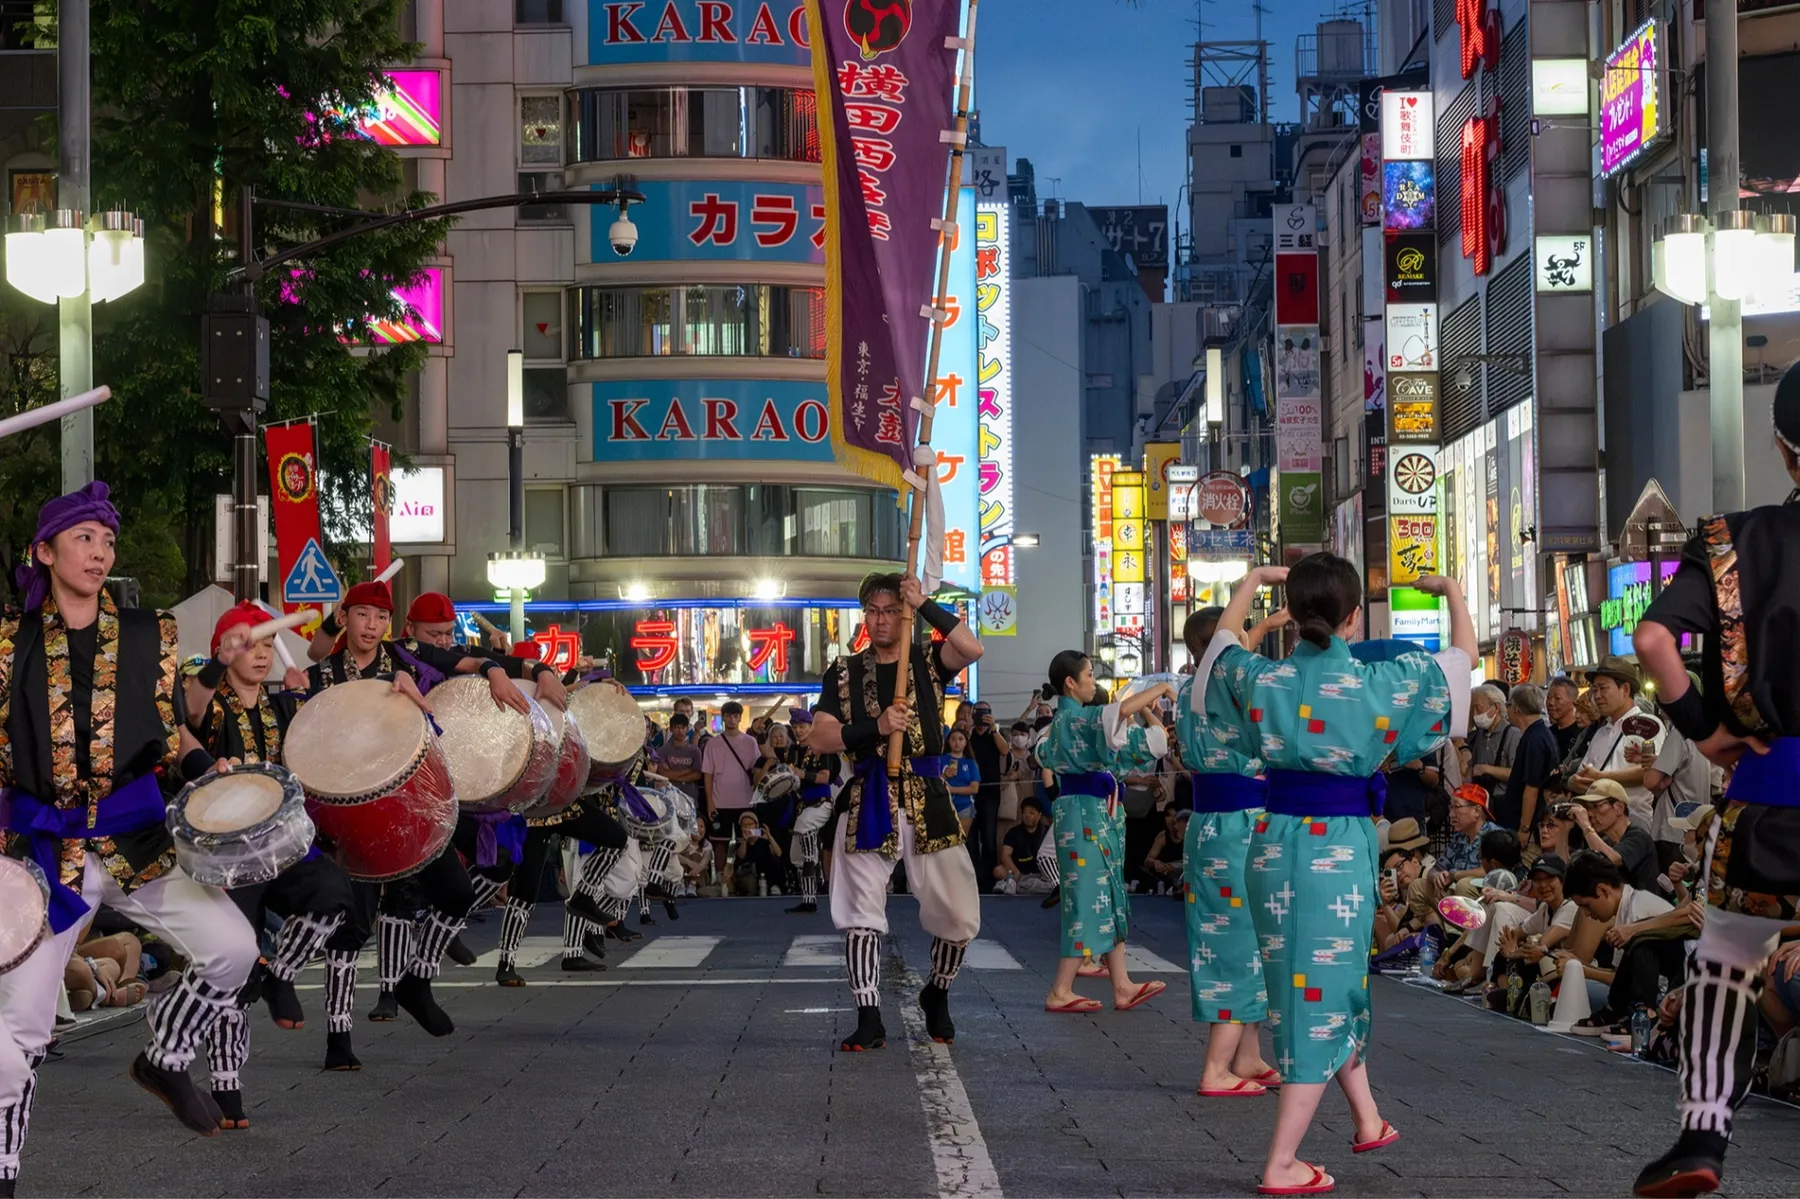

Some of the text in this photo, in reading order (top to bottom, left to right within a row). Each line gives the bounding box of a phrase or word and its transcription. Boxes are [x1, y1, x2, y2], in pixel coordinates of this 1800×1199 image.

[1400, 110, 1411, 155] 歌舞伎町
[687, 193, 825, 250] カラ
[1573, 241, 1585, 251] 5F
[608, 398, 830, 443] KARAO
[1202, 492, 1240, 510] 消火栓
[1392, 497, 1416, 506] Darts
[1398, 519, 1435, 539] 300
[1207, 531, 1254, 547] セキネ
[1122, 552, 1138, 569] 永
[1394, 617, 1440, 627] FamilyMart
